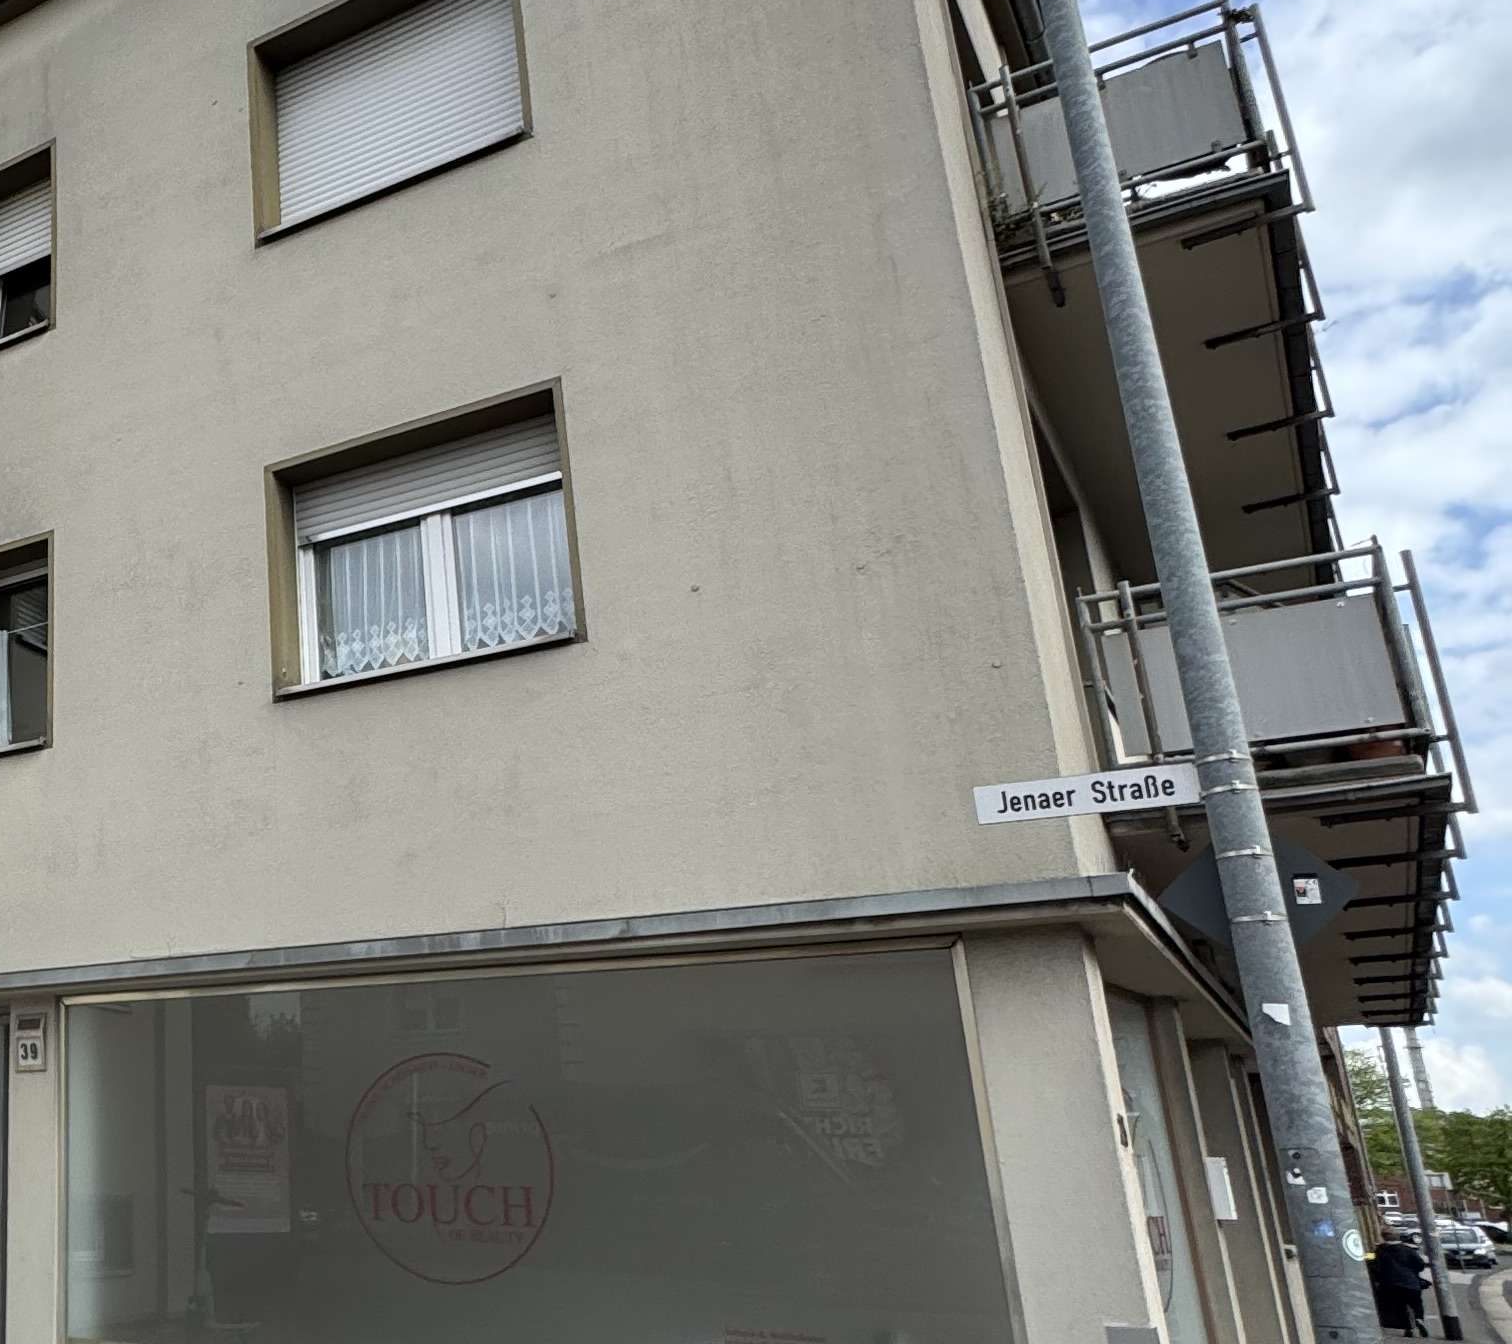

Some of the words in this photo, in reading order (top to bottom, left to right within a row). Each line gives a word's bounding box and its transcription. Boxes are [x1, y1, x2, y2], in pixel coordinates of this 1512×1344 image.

[997, 788, 1076, 814] Jenaer
[1090, 774, 1176, 804] Straße
[20, 1043, 38, 1061] 39
[361, 1182, 537, 1228] TOUCH
